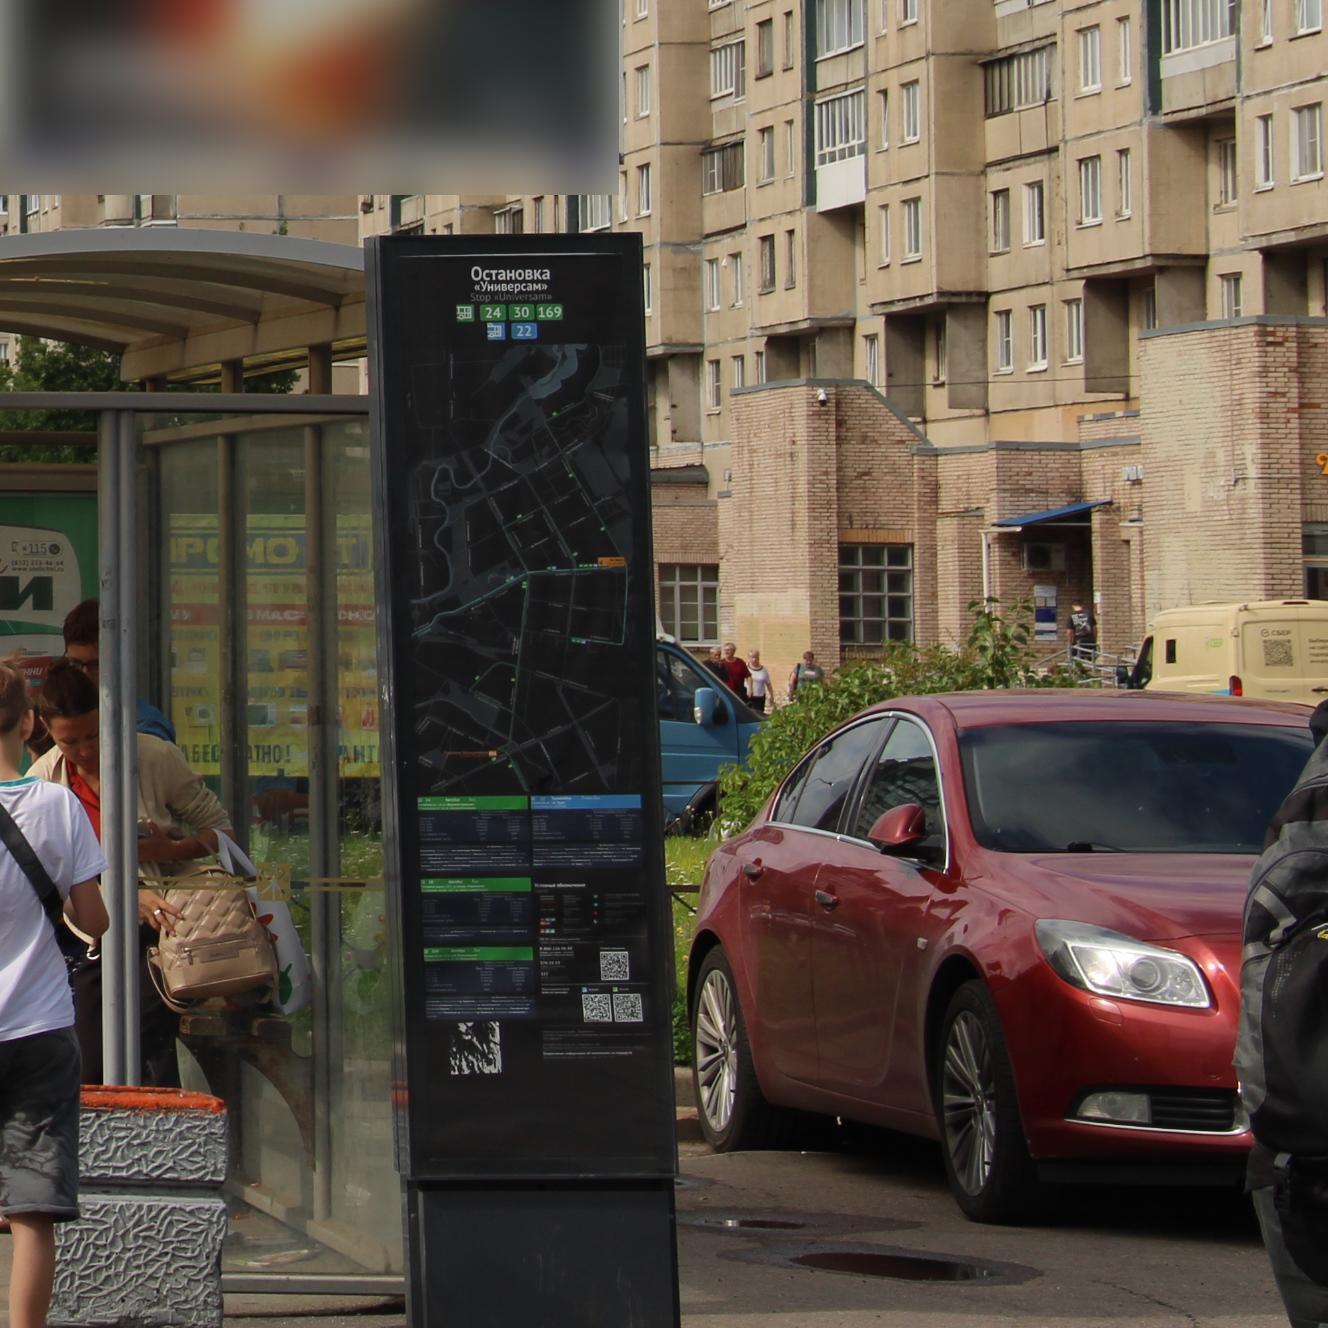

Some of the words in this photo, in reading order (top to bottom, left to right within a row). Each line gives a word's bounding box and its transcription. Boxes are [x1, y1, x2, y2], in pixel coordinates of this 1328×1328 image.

[470, 266, 551, 281] Остановка
[474, 281, 548, 293] «Универсам»
[470, 293, 492, 303] Stop
[494, 292, 553, 302] «Universam»
[485, 306, 502, 318] 24
[513, 306, 530, 318] 30
[538, 306, 563, 318] 169
[516, 325, 532, 337] 22
